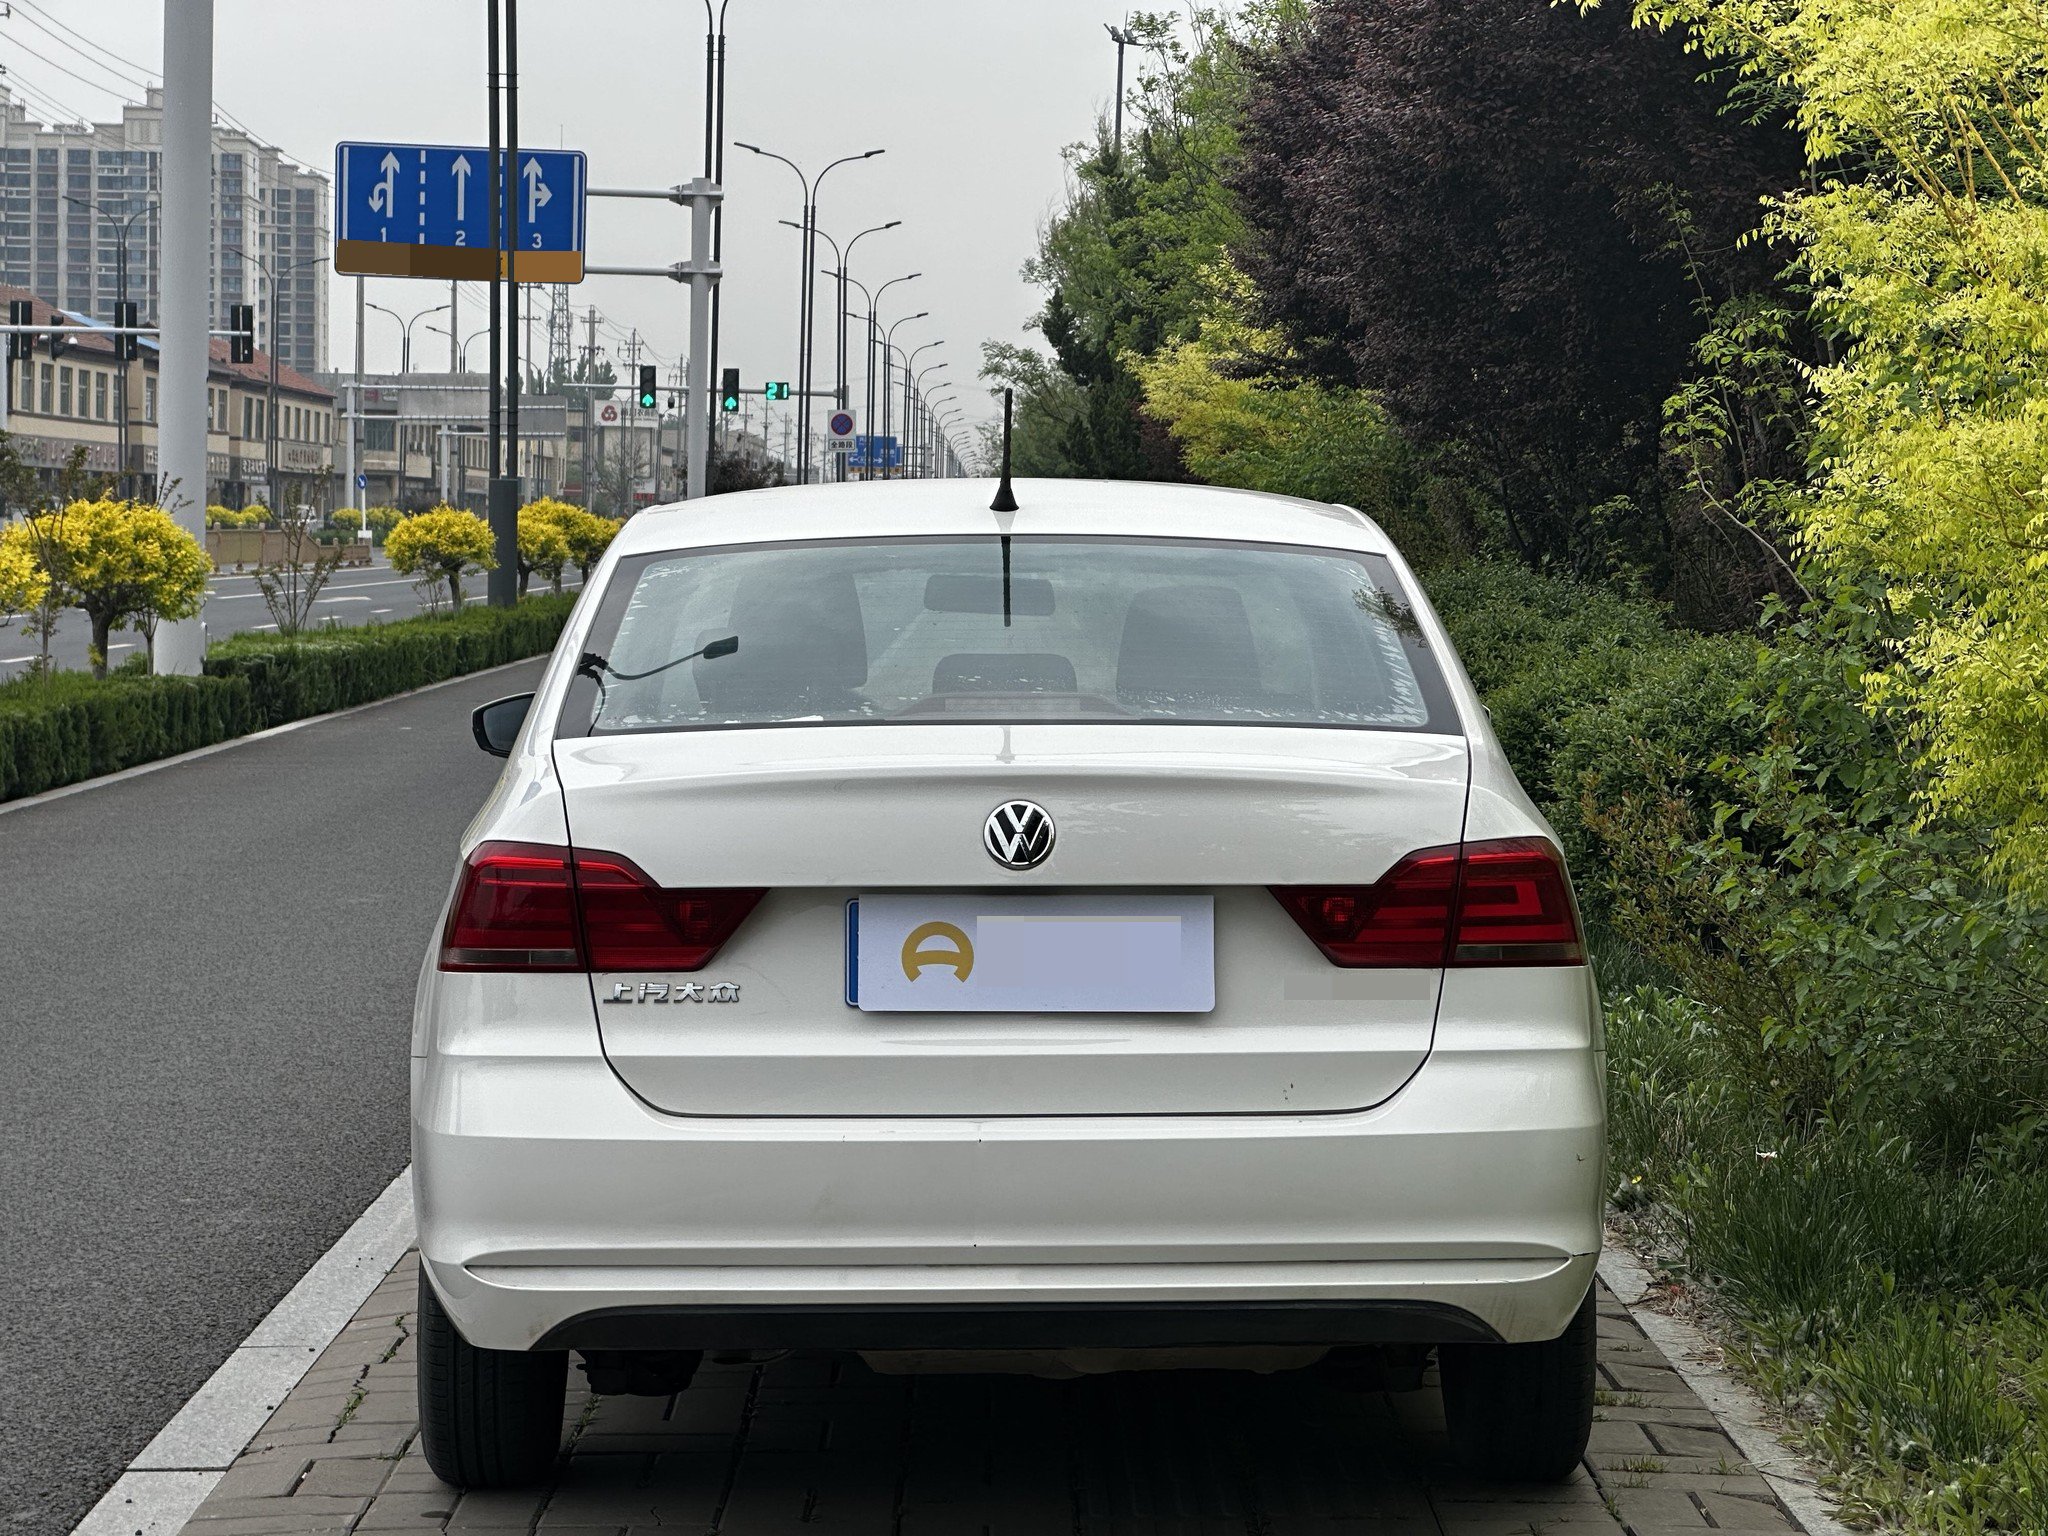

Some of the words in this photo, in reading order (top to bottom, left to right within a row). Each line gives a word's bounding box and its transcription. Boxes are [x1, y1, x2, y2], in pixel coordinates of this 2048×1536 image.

[380, 227, 387, 243] 1
[455, 230, 466, 247] 2
[532, 233, 543, 249] 3
[766, 382, 788, 400] 21
[831, 441, 853, 449] 全路段
[603, 982, 740, 1004] 上汽大众
